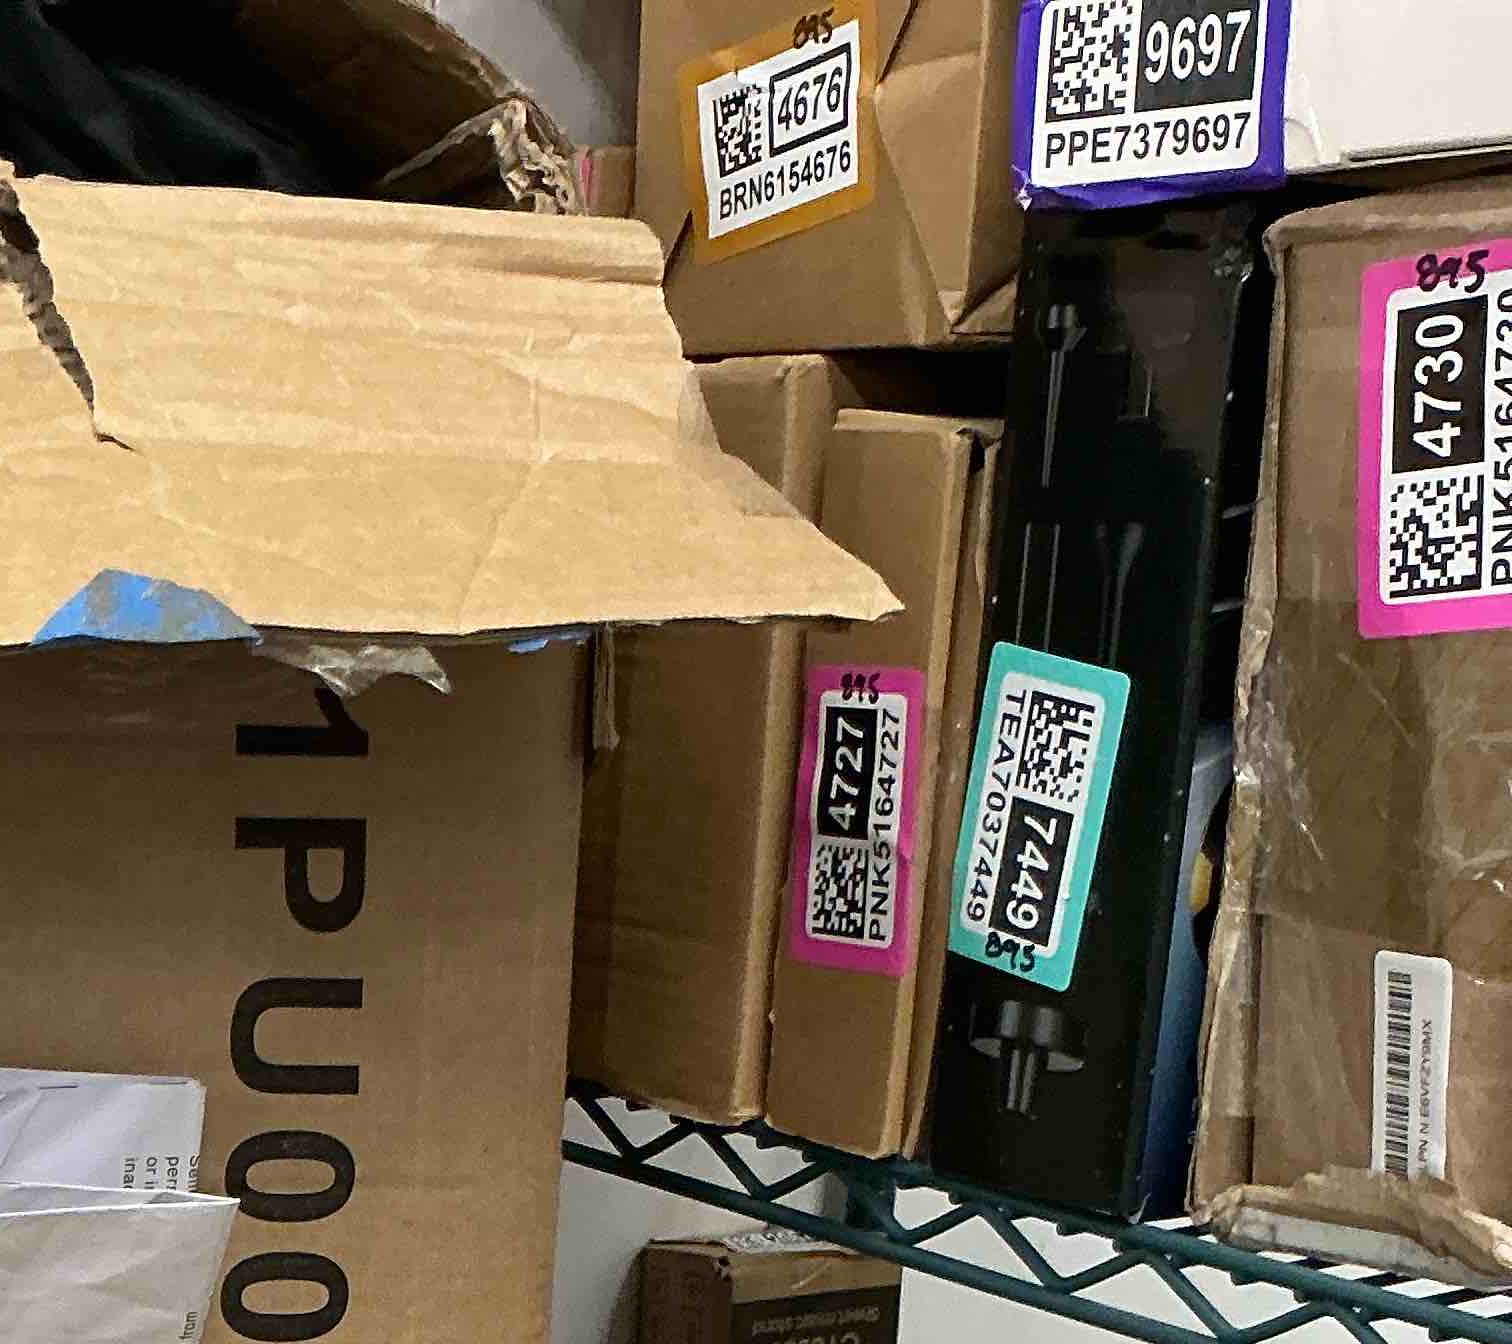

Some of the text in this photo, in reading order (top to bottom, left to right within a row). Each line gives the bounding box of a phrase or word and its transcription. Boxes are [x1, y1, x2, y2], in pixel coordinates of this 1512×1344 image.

[1143, 9, 1252, 85] 9697
[777, 66, 843, 131] 4676
[1045, 111, 1252, 169] PPE7379697
[718, 140, 851, 221] BRN6154676
[1415, 249, 1490, 293] 895
[1411, 314, 1465, 458] 4730
[841, 672, 881, 704] 895
[828, 715, 865, 832] 4727
[965, 688, 1028, 924] TEA7037449
[867, 708, 901, 942] PNK5164727
[1004, 813, 1059, 930] 7449
[985, 930, 1037, 972] 895
[184, 1310, 198, 1342] from
